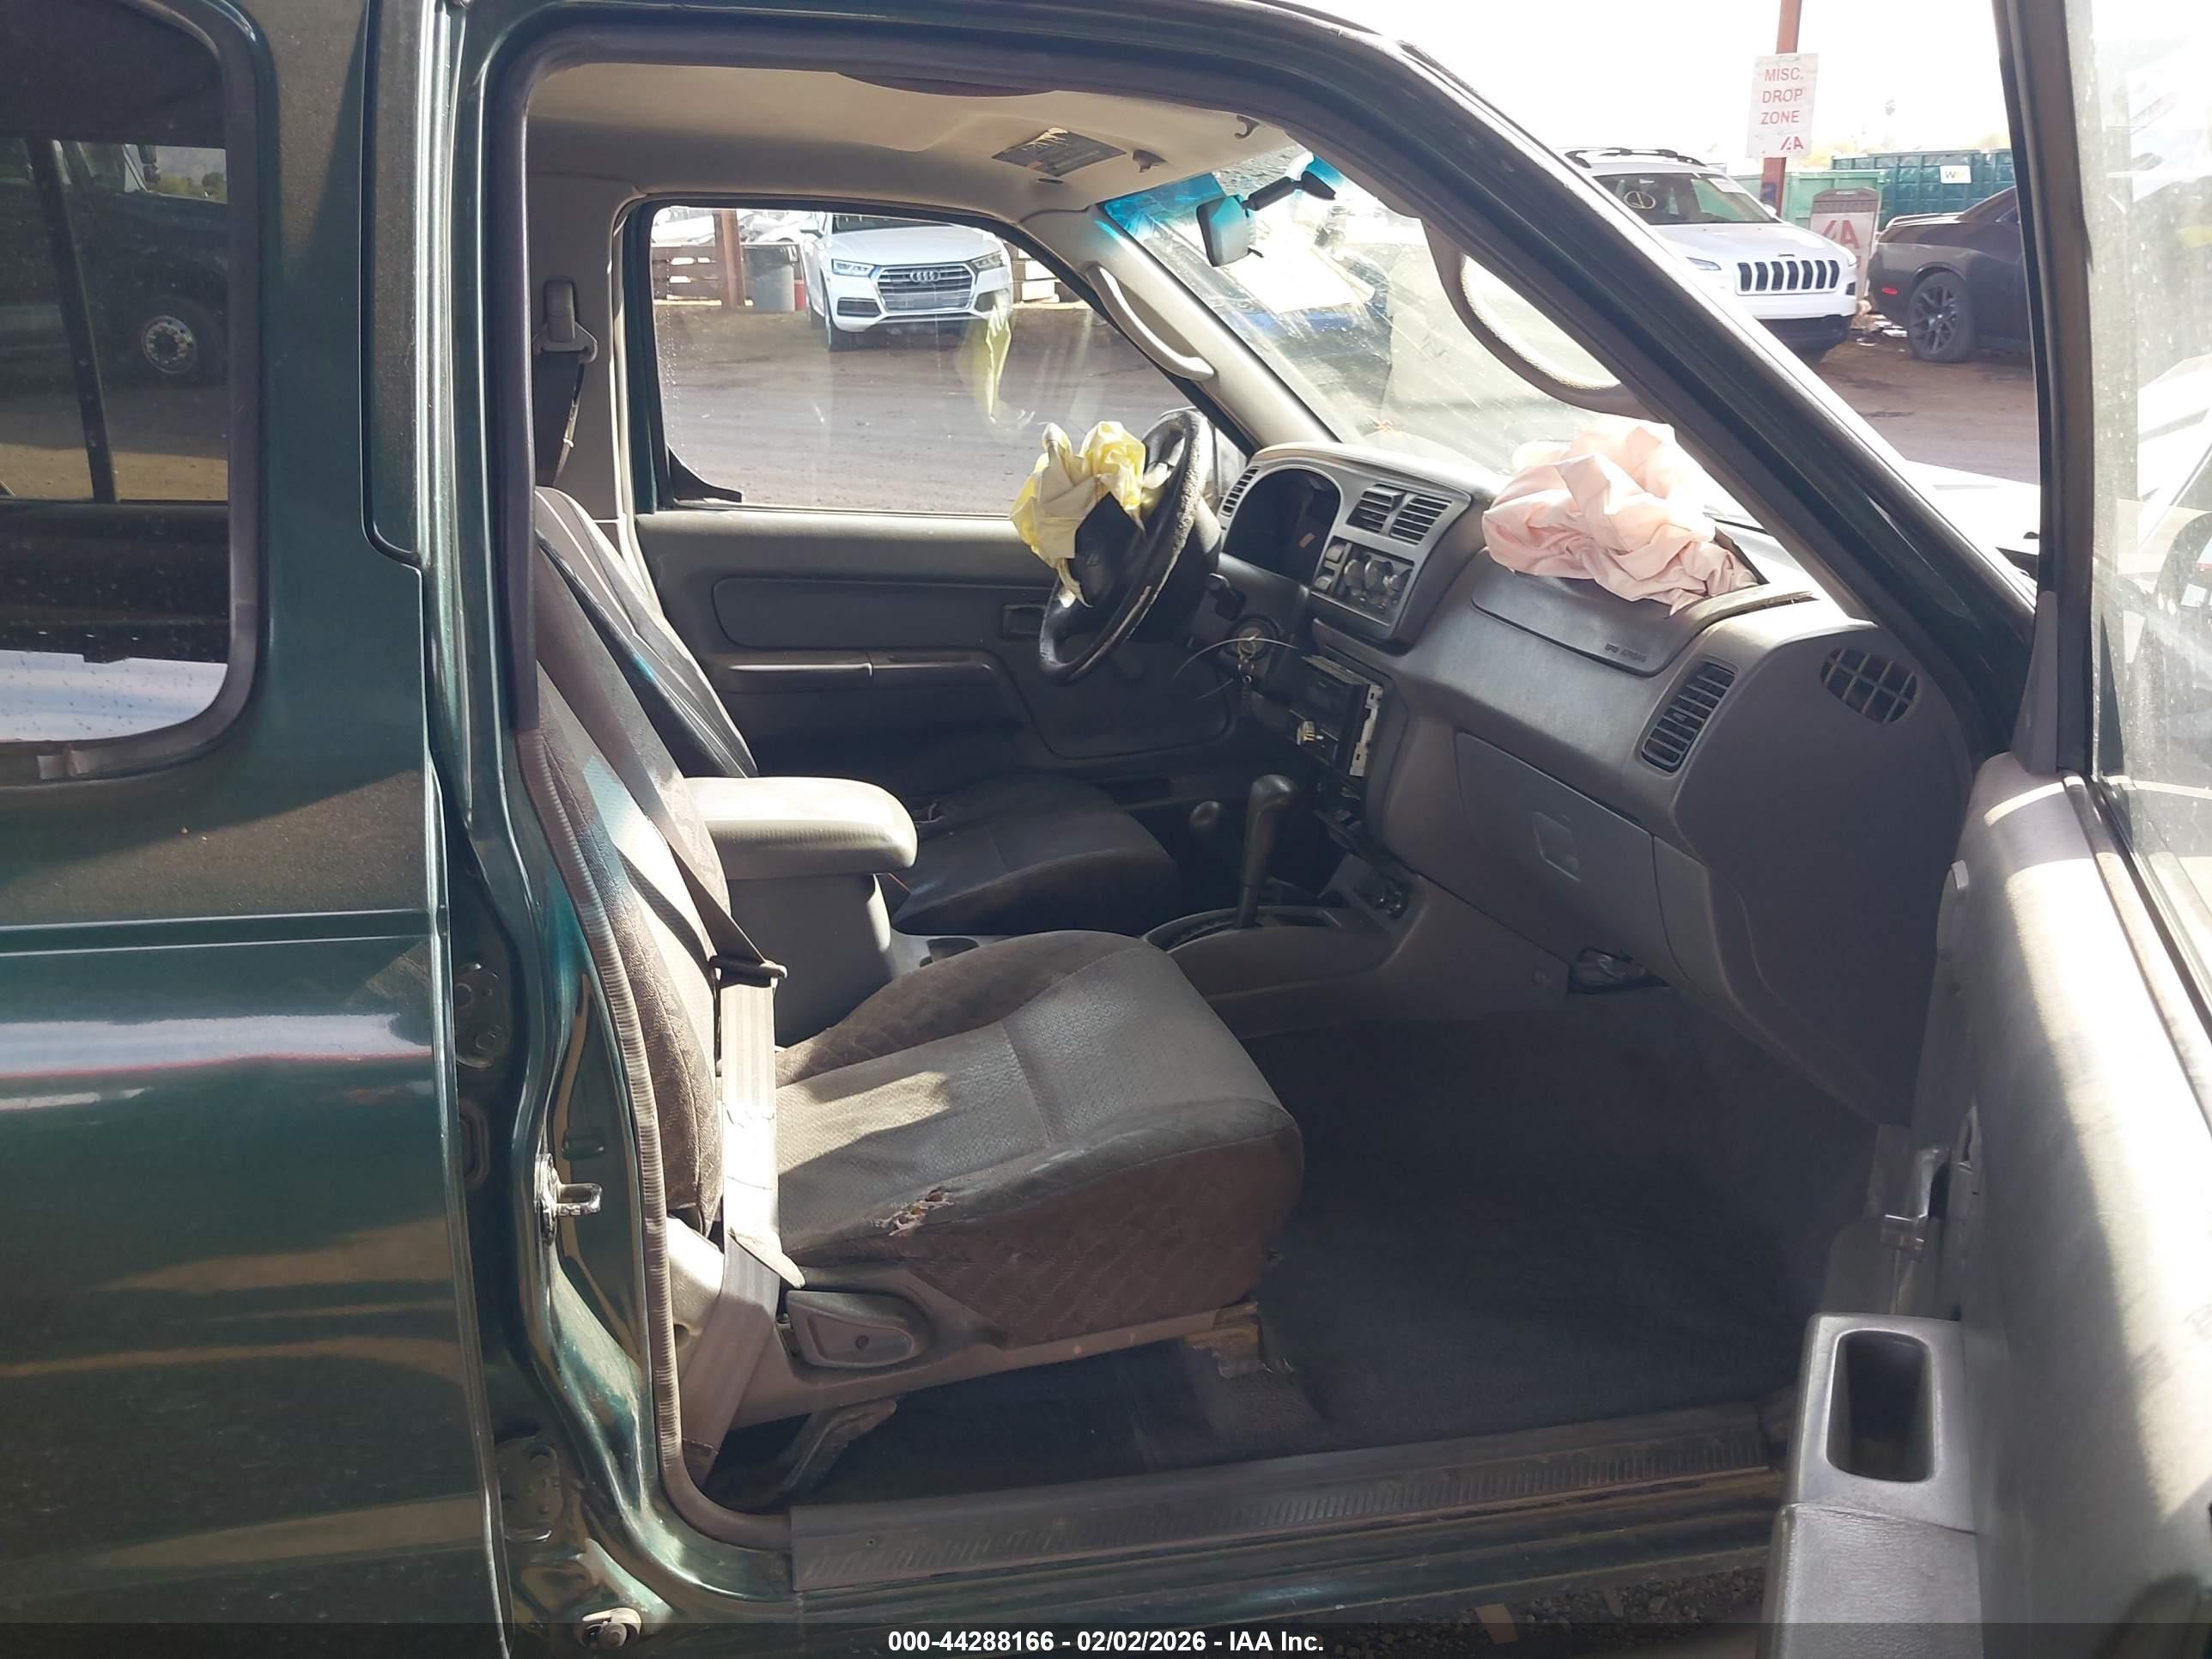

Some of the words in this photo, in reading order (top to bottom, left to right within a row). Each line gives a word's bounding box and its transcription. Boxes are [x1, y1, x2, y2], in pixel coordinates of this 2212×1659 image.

[1765, 67, 1804, 82] MISC.
[1762, 88, 1803, 103] DROP
[1760, 110, 1801, 125] ZONE
